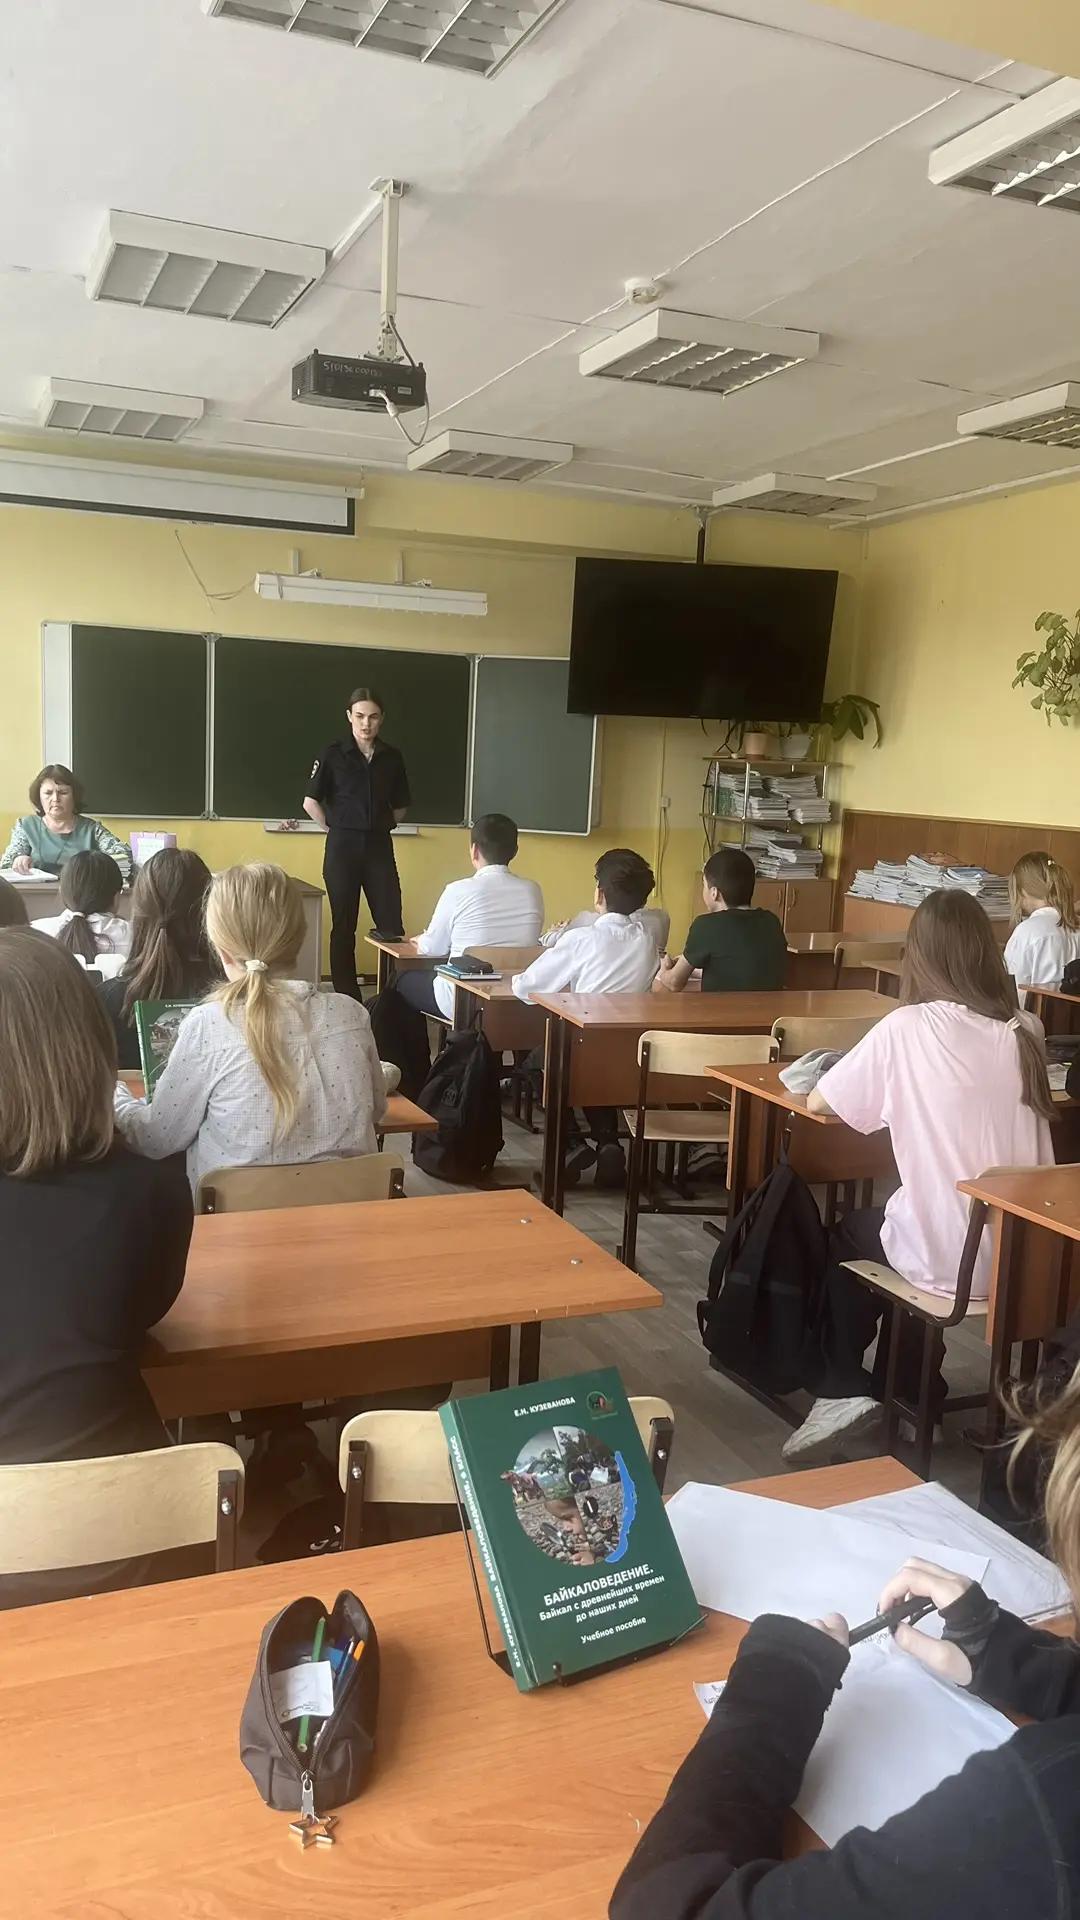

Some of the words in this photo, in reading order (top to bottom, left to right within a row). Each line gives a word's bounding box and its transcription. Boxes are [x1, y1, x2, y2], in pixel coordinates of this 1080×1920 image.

[514, 1408, 529, 1417] Е.Н.
[530, 1397, 576, 1413] КУЗЕВАНОВА
[450, 1435, 465, 1471] КЛАСС
[539, 1605, 573, 1621] Байкал
[574, 1602, 580, 1610] с
[581, 1585, 634, 1610] древнейших
[635, 1575, 665, 1591] времен
[543, 1563, 654, 1606] БАЙКАЛОВЕДЕНИЕ.
[494, 1586, 514, 1646] КУЗЕВАНОВА
[576, 1613, 587, 1623] до
[588, 1604, 617, 1618] наших
[618, 1594, 640, 1609] дней
[580, 1627, 615, 1644] Учебное
[615, 1616, 647, 1633] пособие
